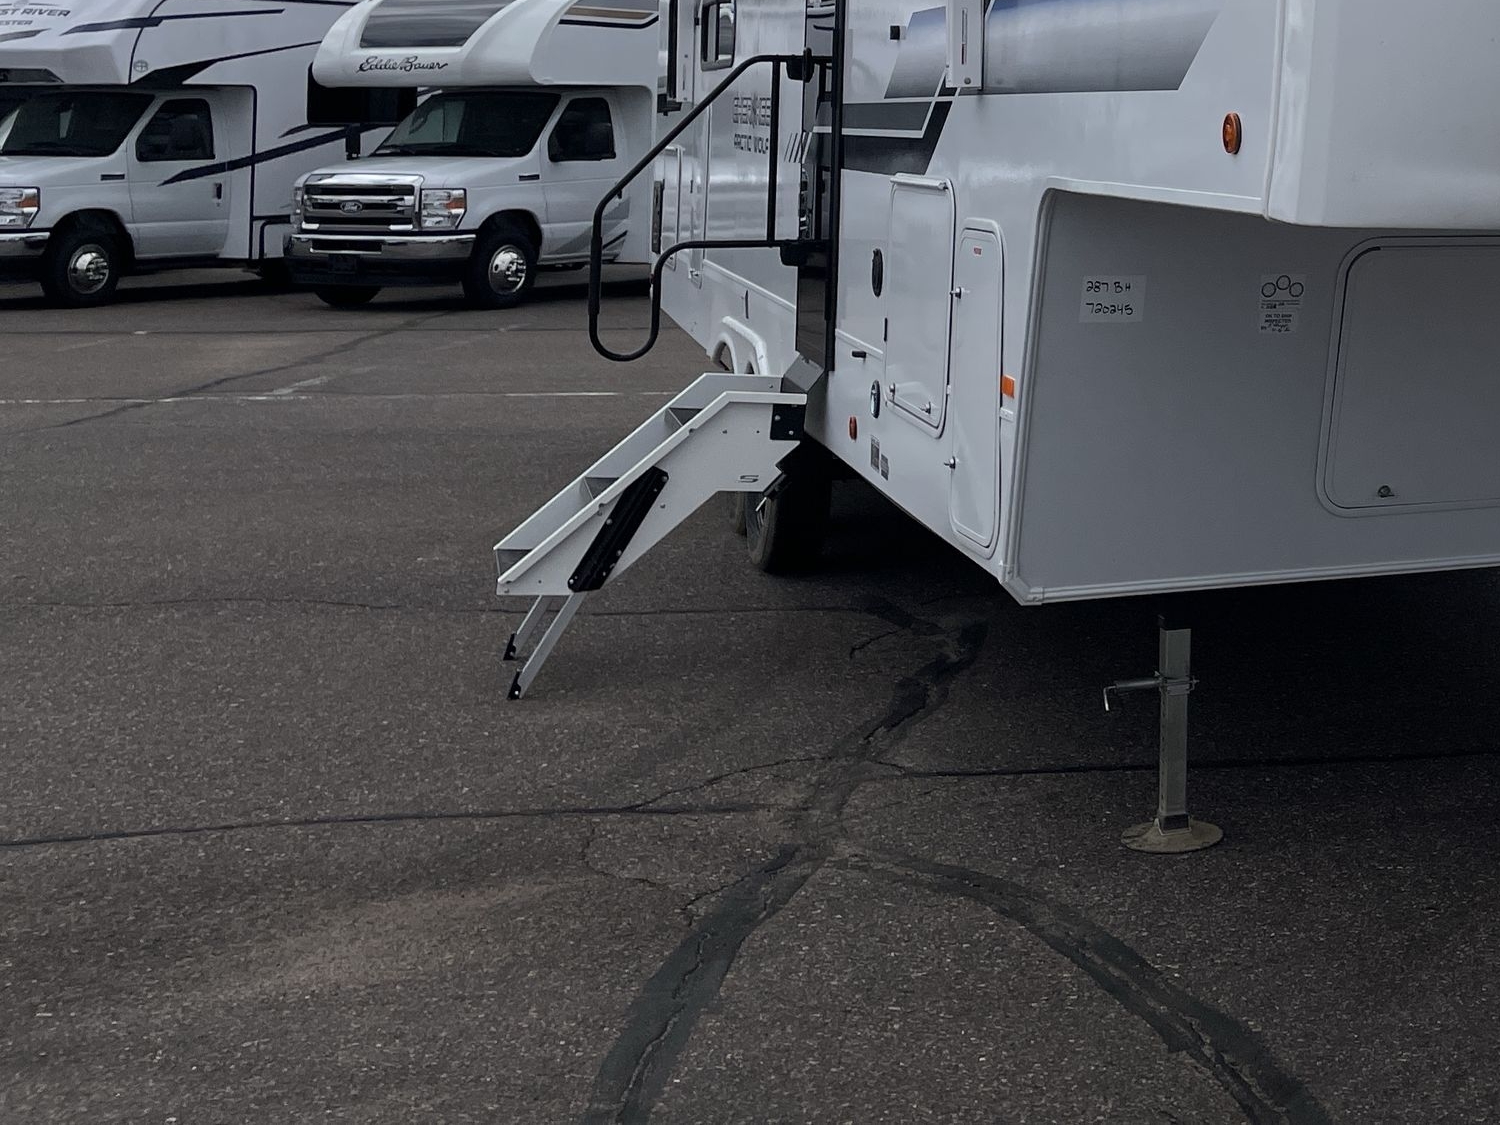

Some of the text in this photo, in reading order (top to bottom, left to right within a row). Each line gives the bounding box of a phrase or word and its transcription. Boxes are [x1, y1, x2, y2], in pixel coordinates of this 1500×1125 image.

[21, 8, 71, 17] RIVER
[356, 55, 449, 73] Eddie Bauer
[1086, 280, 1109, 293] 287
[1085, 302, 1134, 316] 720245
